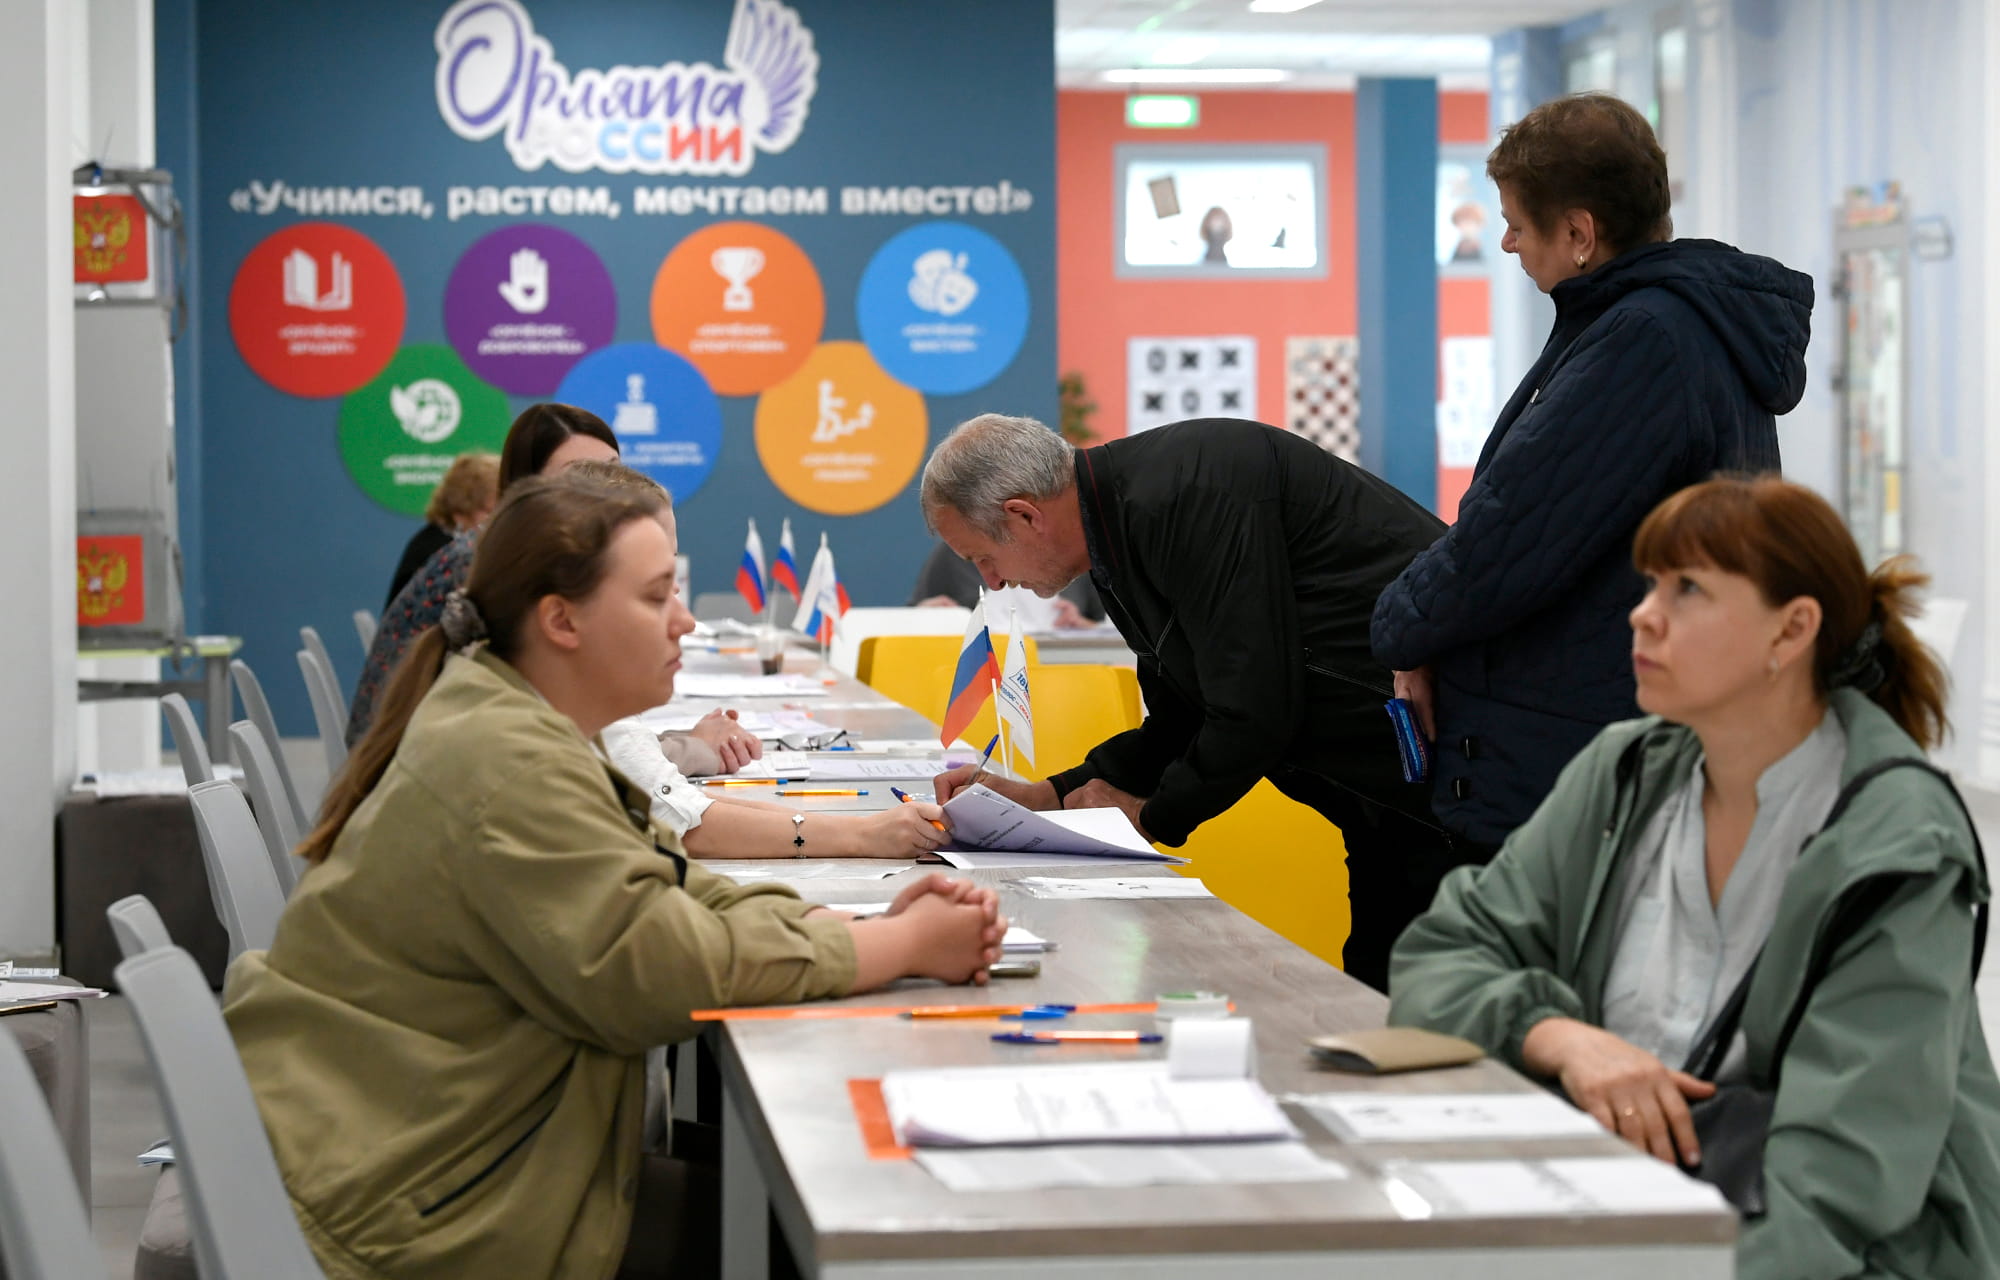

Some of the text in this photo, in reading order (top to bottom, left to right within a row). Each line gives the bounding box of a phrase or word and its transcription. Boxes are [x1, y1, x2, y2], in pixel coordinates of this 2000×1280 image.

[445, 1, 747, 142] Орлята
[524, 122, 742, 162] РОССИИ
[230, 180, 1032, 221] «Учимся, растем, мечтаем вместе!»
